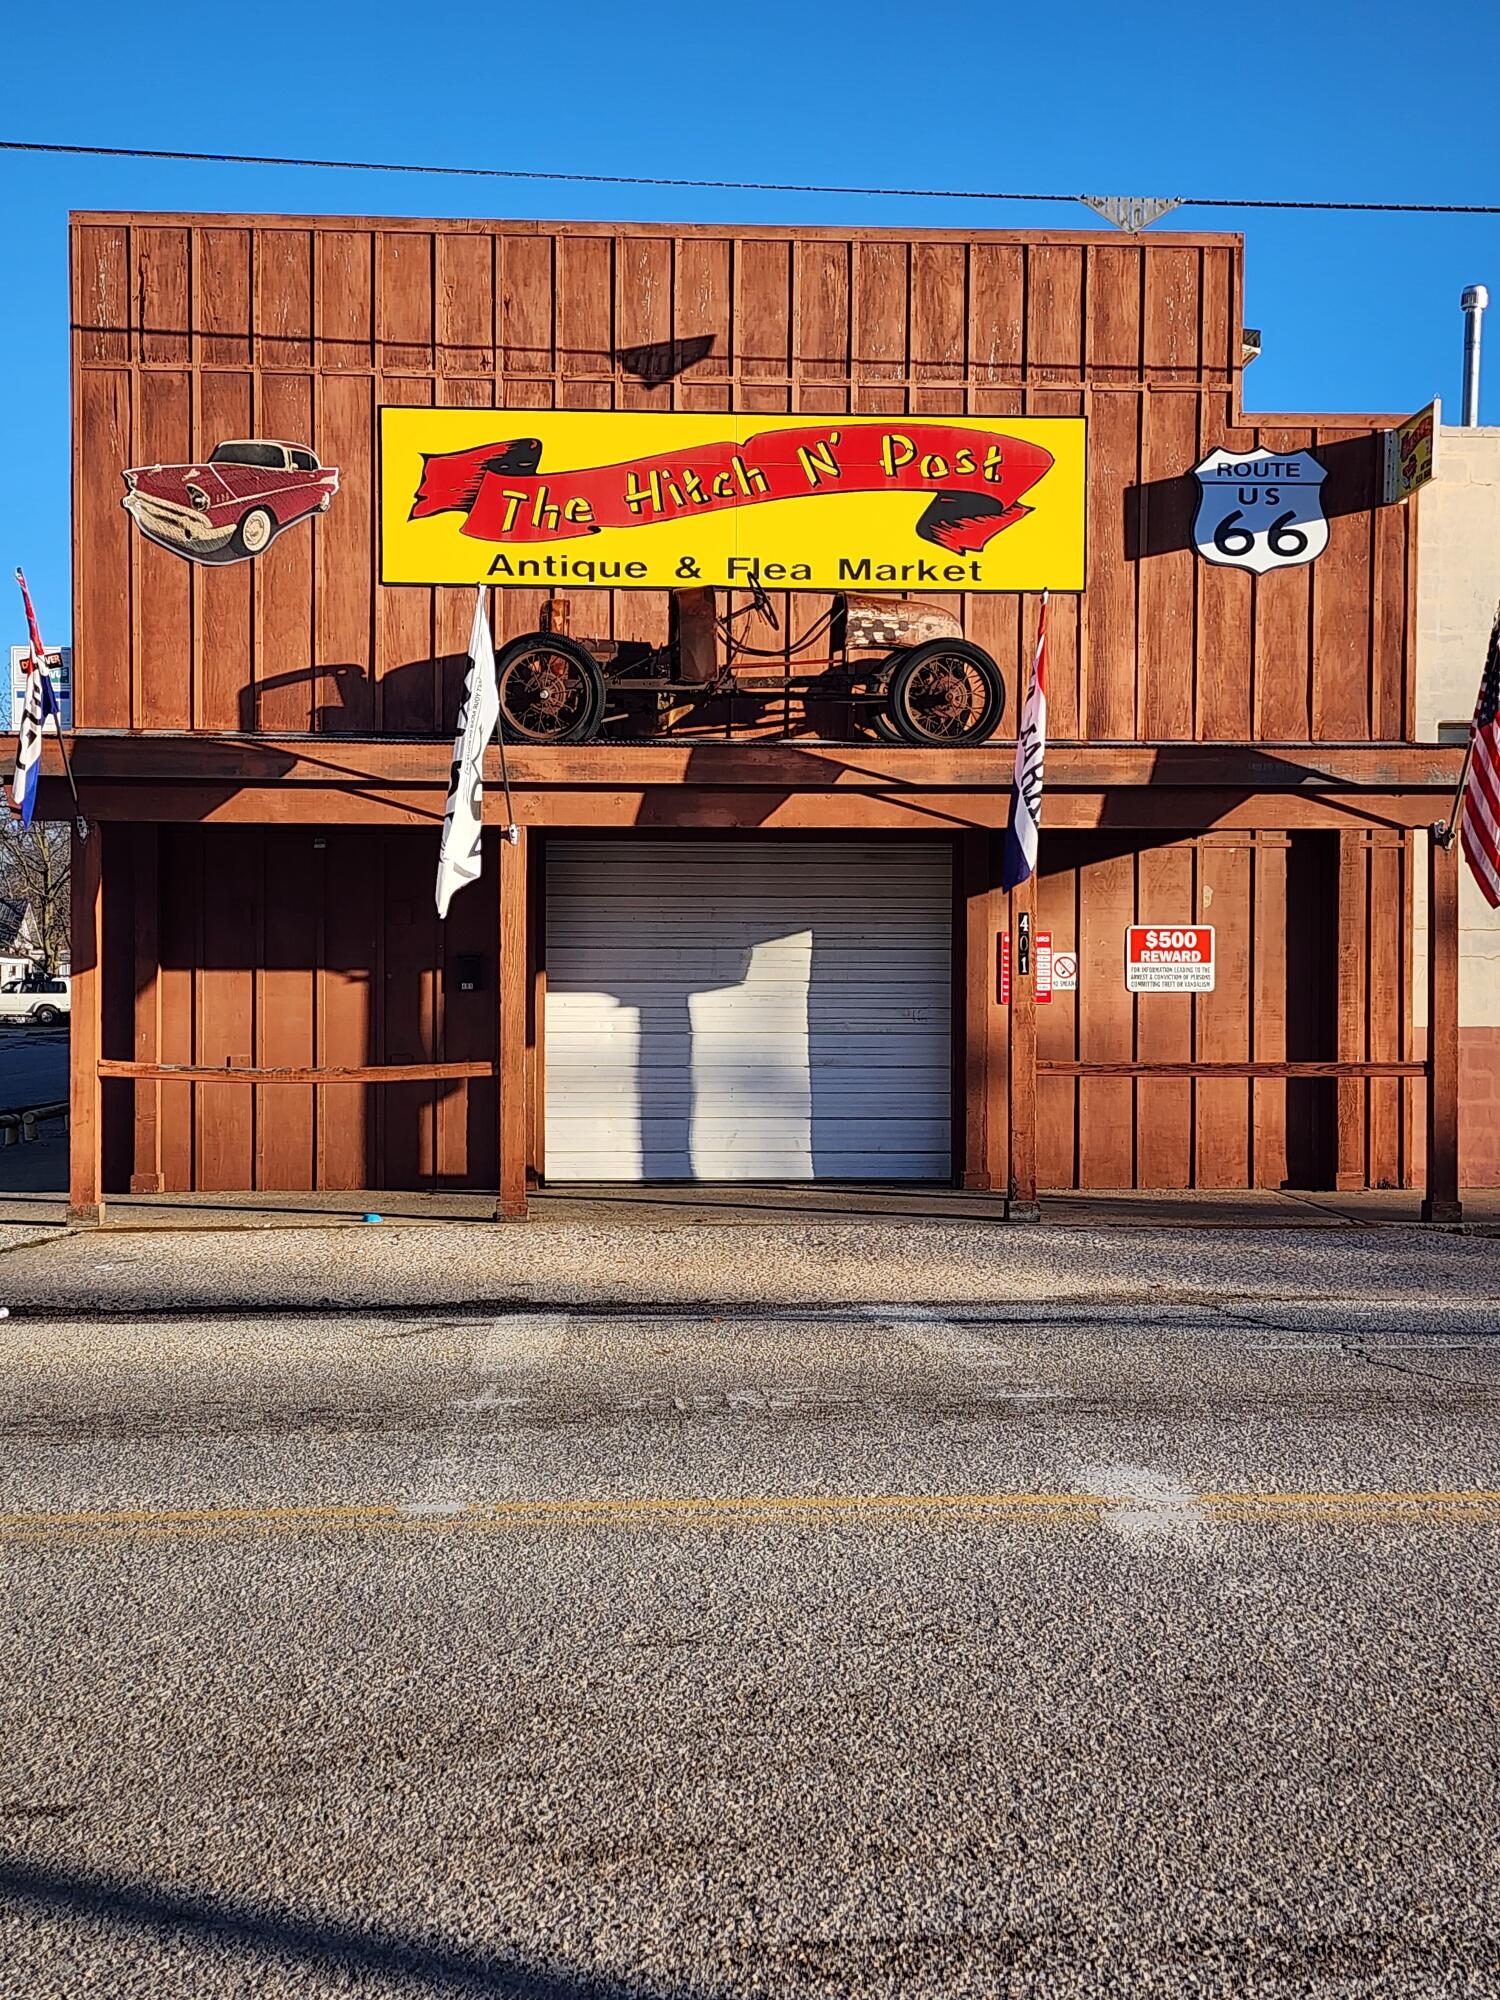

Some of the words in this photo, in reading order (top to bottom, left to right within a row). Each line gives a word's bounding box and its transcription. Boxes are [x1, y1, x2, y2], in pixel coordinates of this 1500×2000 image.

[501, 486, 593, 532] The
[624, 456, 768, 514] Hitch
[795, 430, 842, 487] N'
[879, 433, 1005, 480] Post
[1216, 462, 1302, 478] ROUTE
[1238, 487, 1282, 506] US
[1213, 510, 1309, 557] 66
[486, 553, 648, 587] Antique
[674, 556, 702, 580] &
[727, 557, 813, 581] Flea
[839, 558, 984, 582] Market
[1019, 914, 1029, 973] 401
[1145, 930, 1198, 949] $500
[1140, 950, 1202, 962] REWARD
